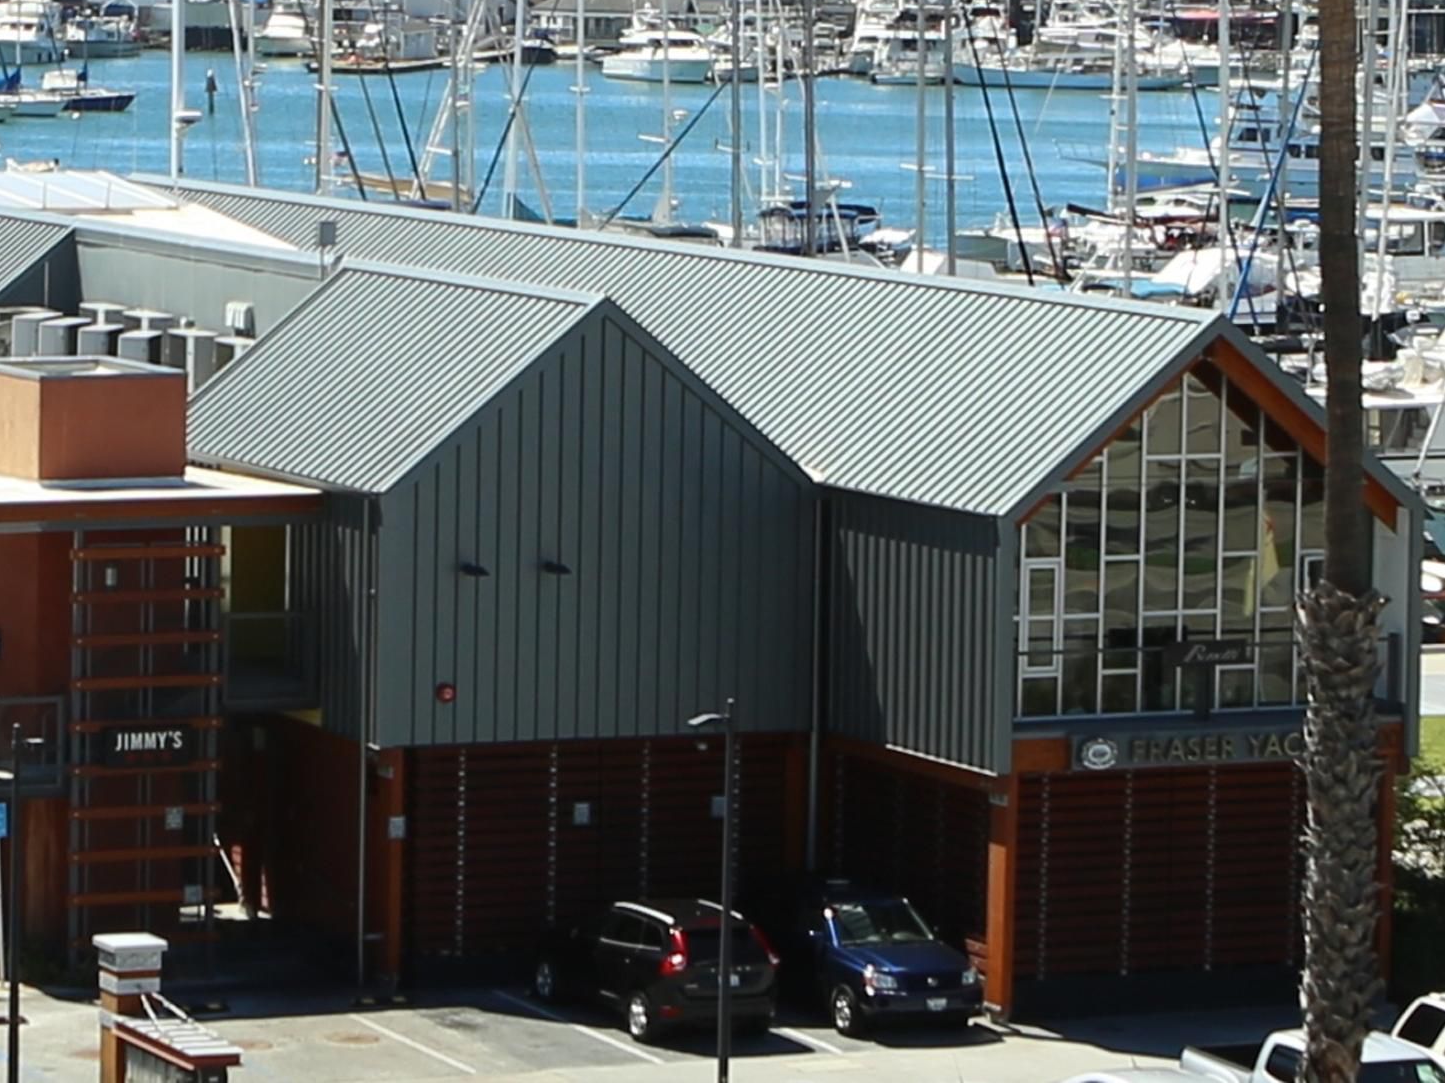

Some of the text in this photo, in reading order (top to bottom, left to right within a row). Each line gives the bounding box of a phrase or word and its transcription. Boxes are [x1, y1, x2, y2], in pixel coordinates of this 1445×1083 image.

[115, 731, 183, 752] JIMMY'S
[1132, 736, 1236, 763] FRASER
[1248, 732, 1302, 757] YAC
